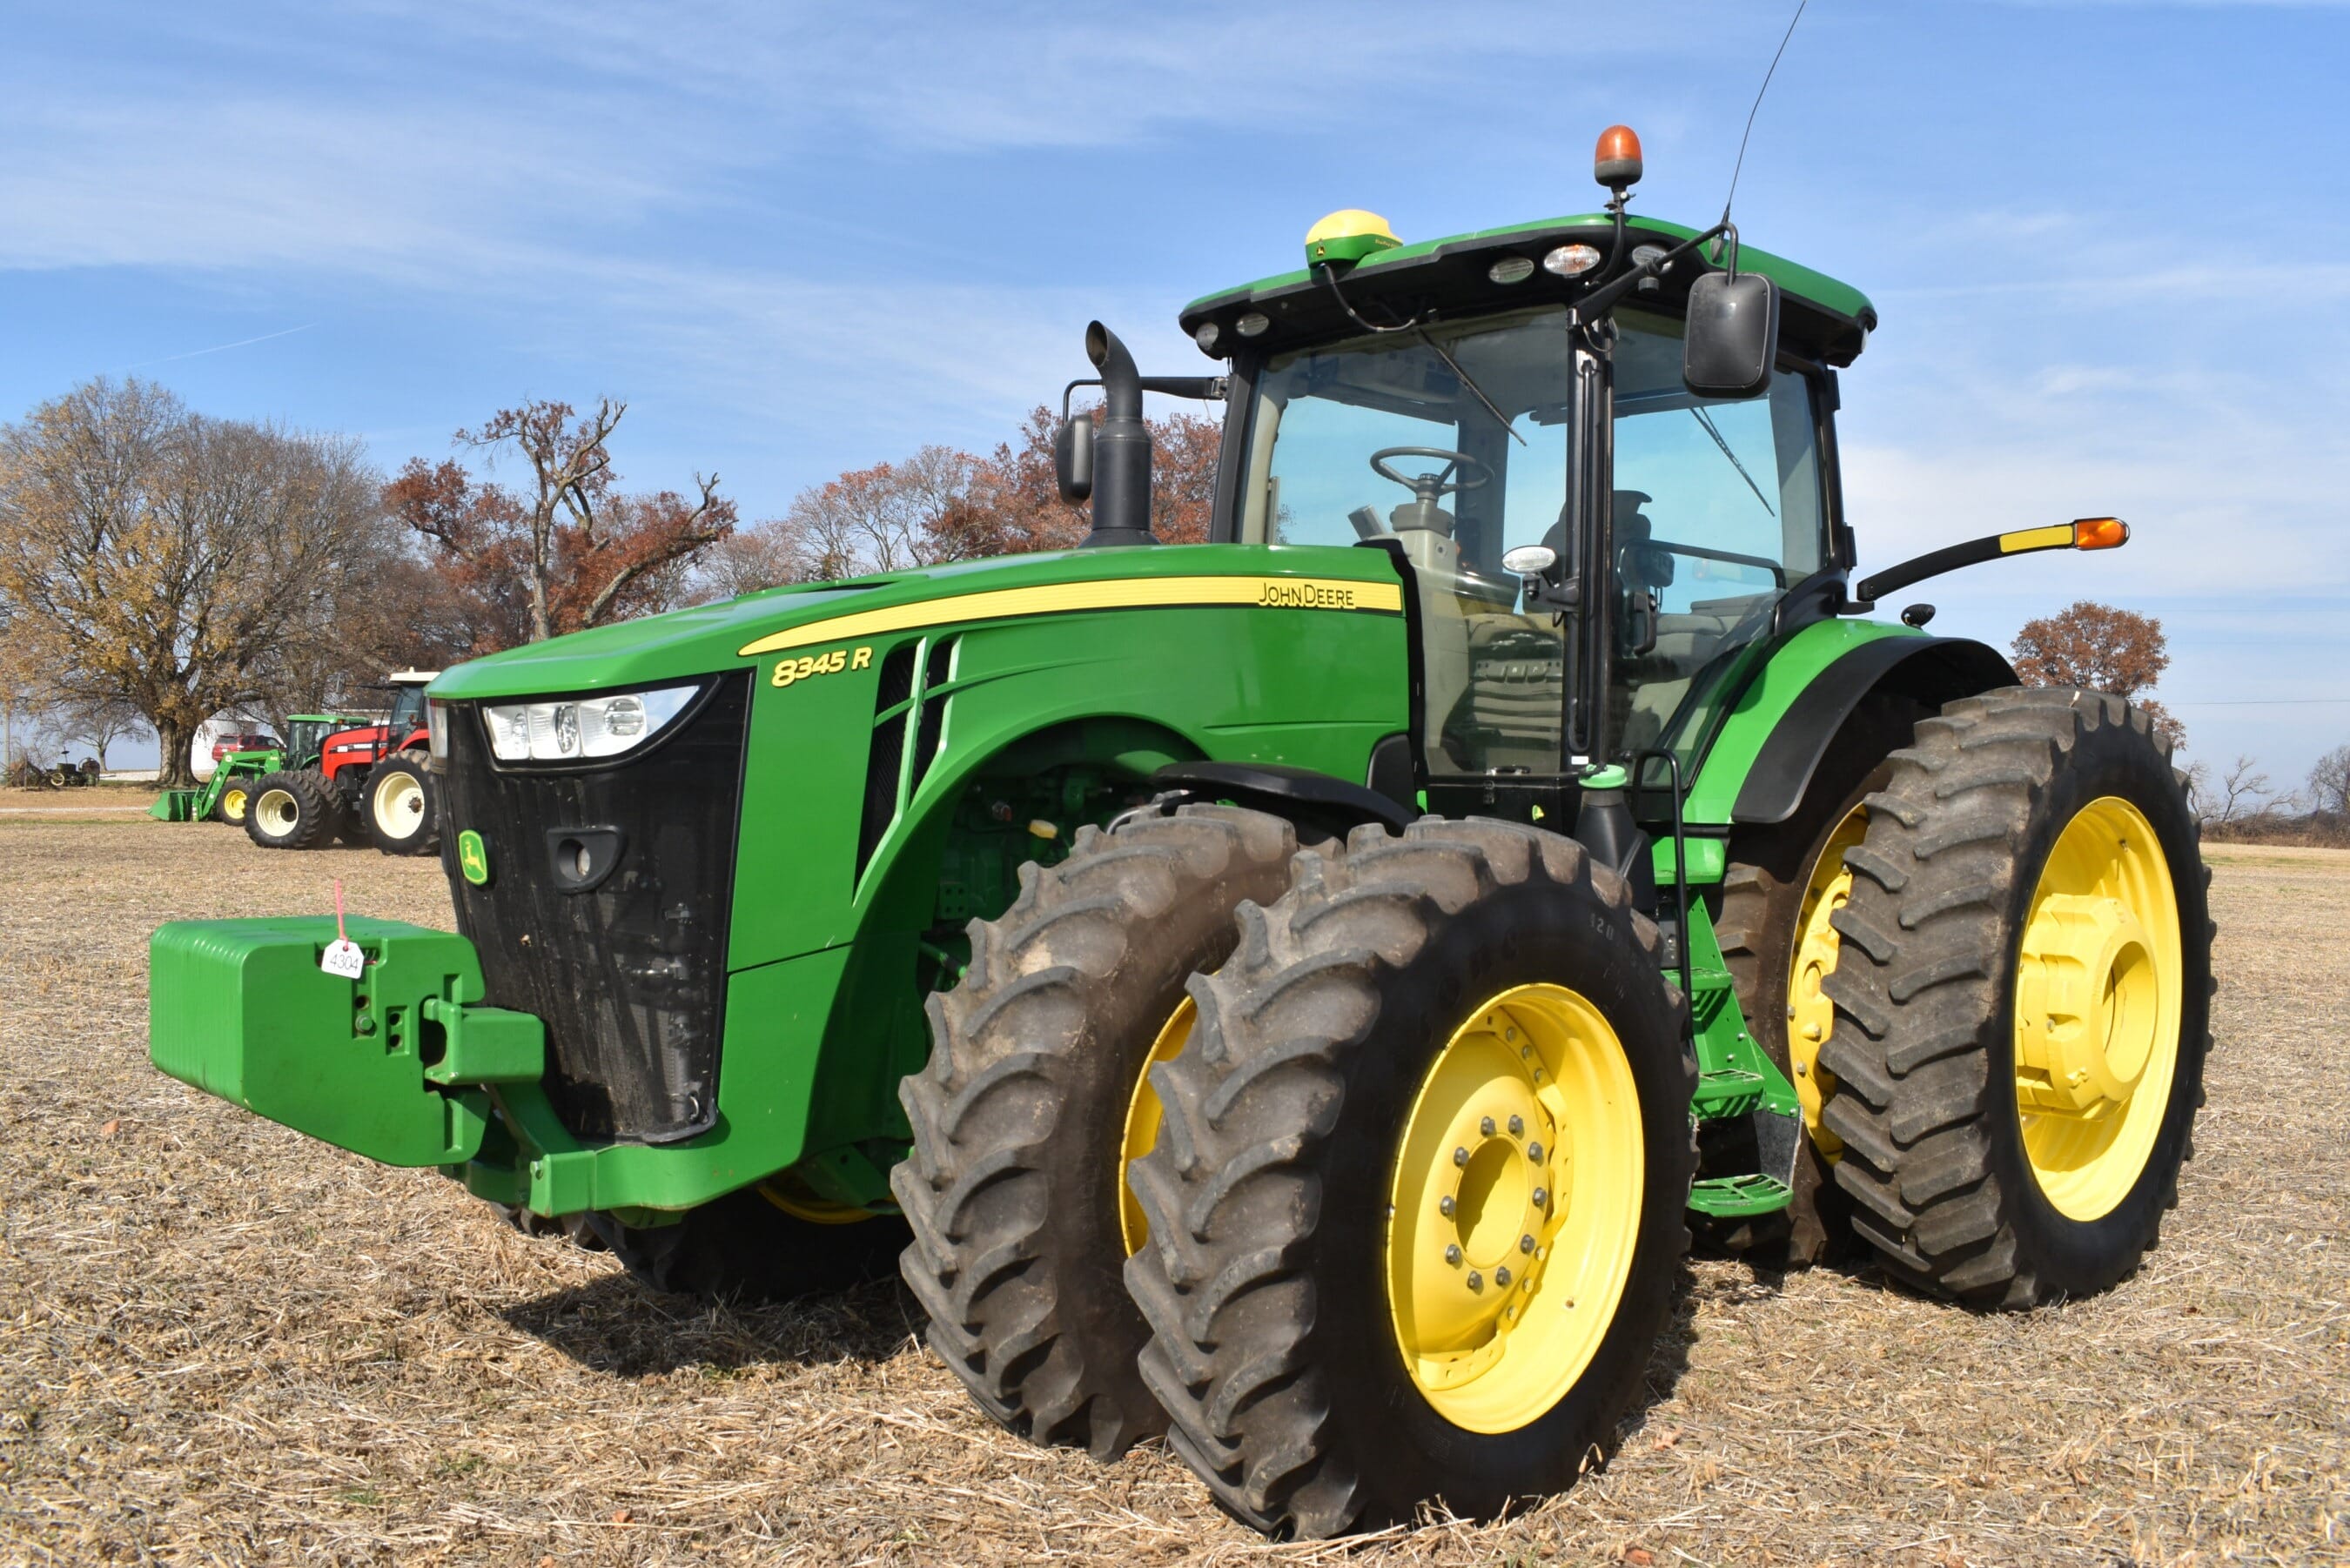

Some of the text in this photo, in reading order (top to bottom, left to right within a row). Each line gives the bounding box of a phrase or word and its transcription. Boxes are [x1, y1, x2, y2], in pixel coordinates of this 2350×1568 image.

[1259, 582, 1354, 606] JOHN DEERE
[771, 647, 873, 687] 8345 R
[329, 953, 359, 972] 4304
